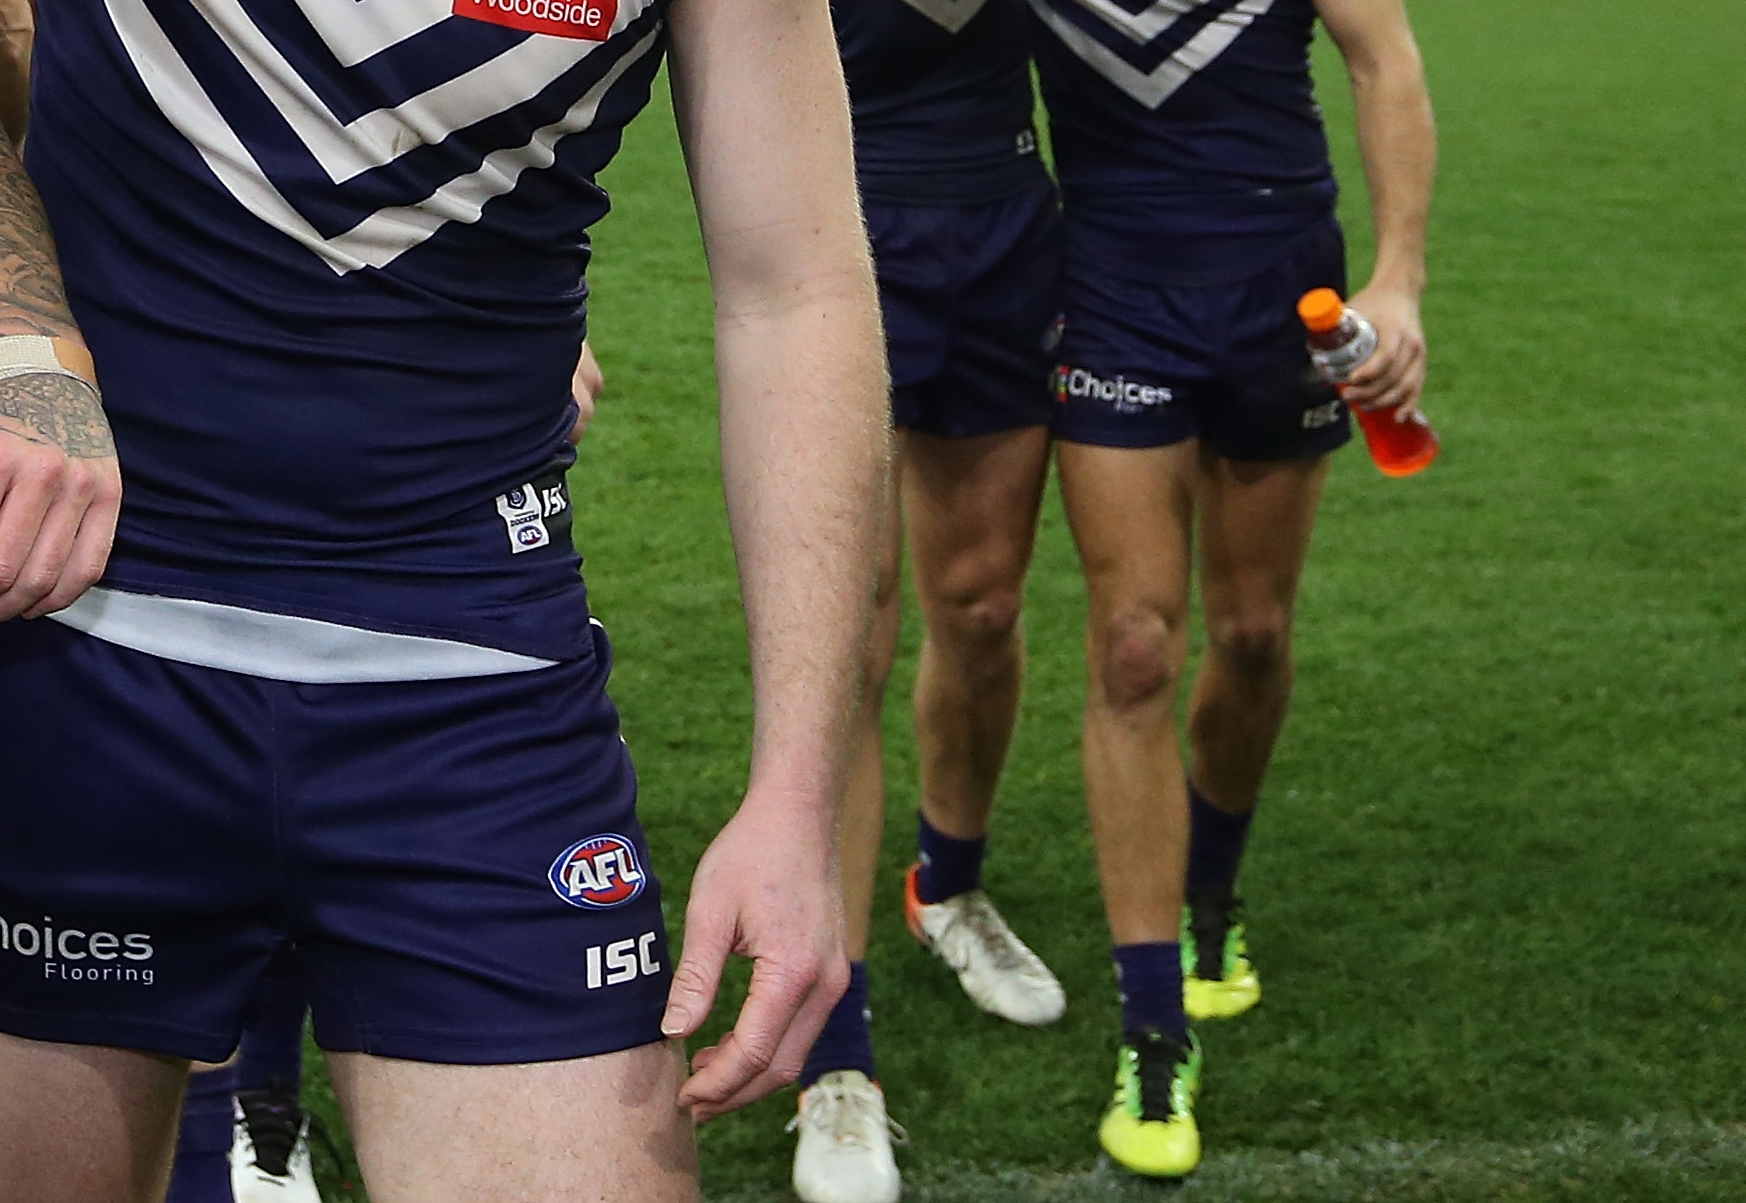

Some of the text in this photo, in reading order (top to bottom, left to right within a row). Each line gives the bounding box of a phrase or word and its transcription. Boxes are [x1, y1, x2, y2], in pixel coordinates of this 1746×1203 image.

[1068, 369, 1173, 406] Choices
[520, 529, 542, 542] AFL
[568, 848, 641, 897] AFL
[45, 962, 154, 986] Flooring
[586, 931, 661, 989] ISC
